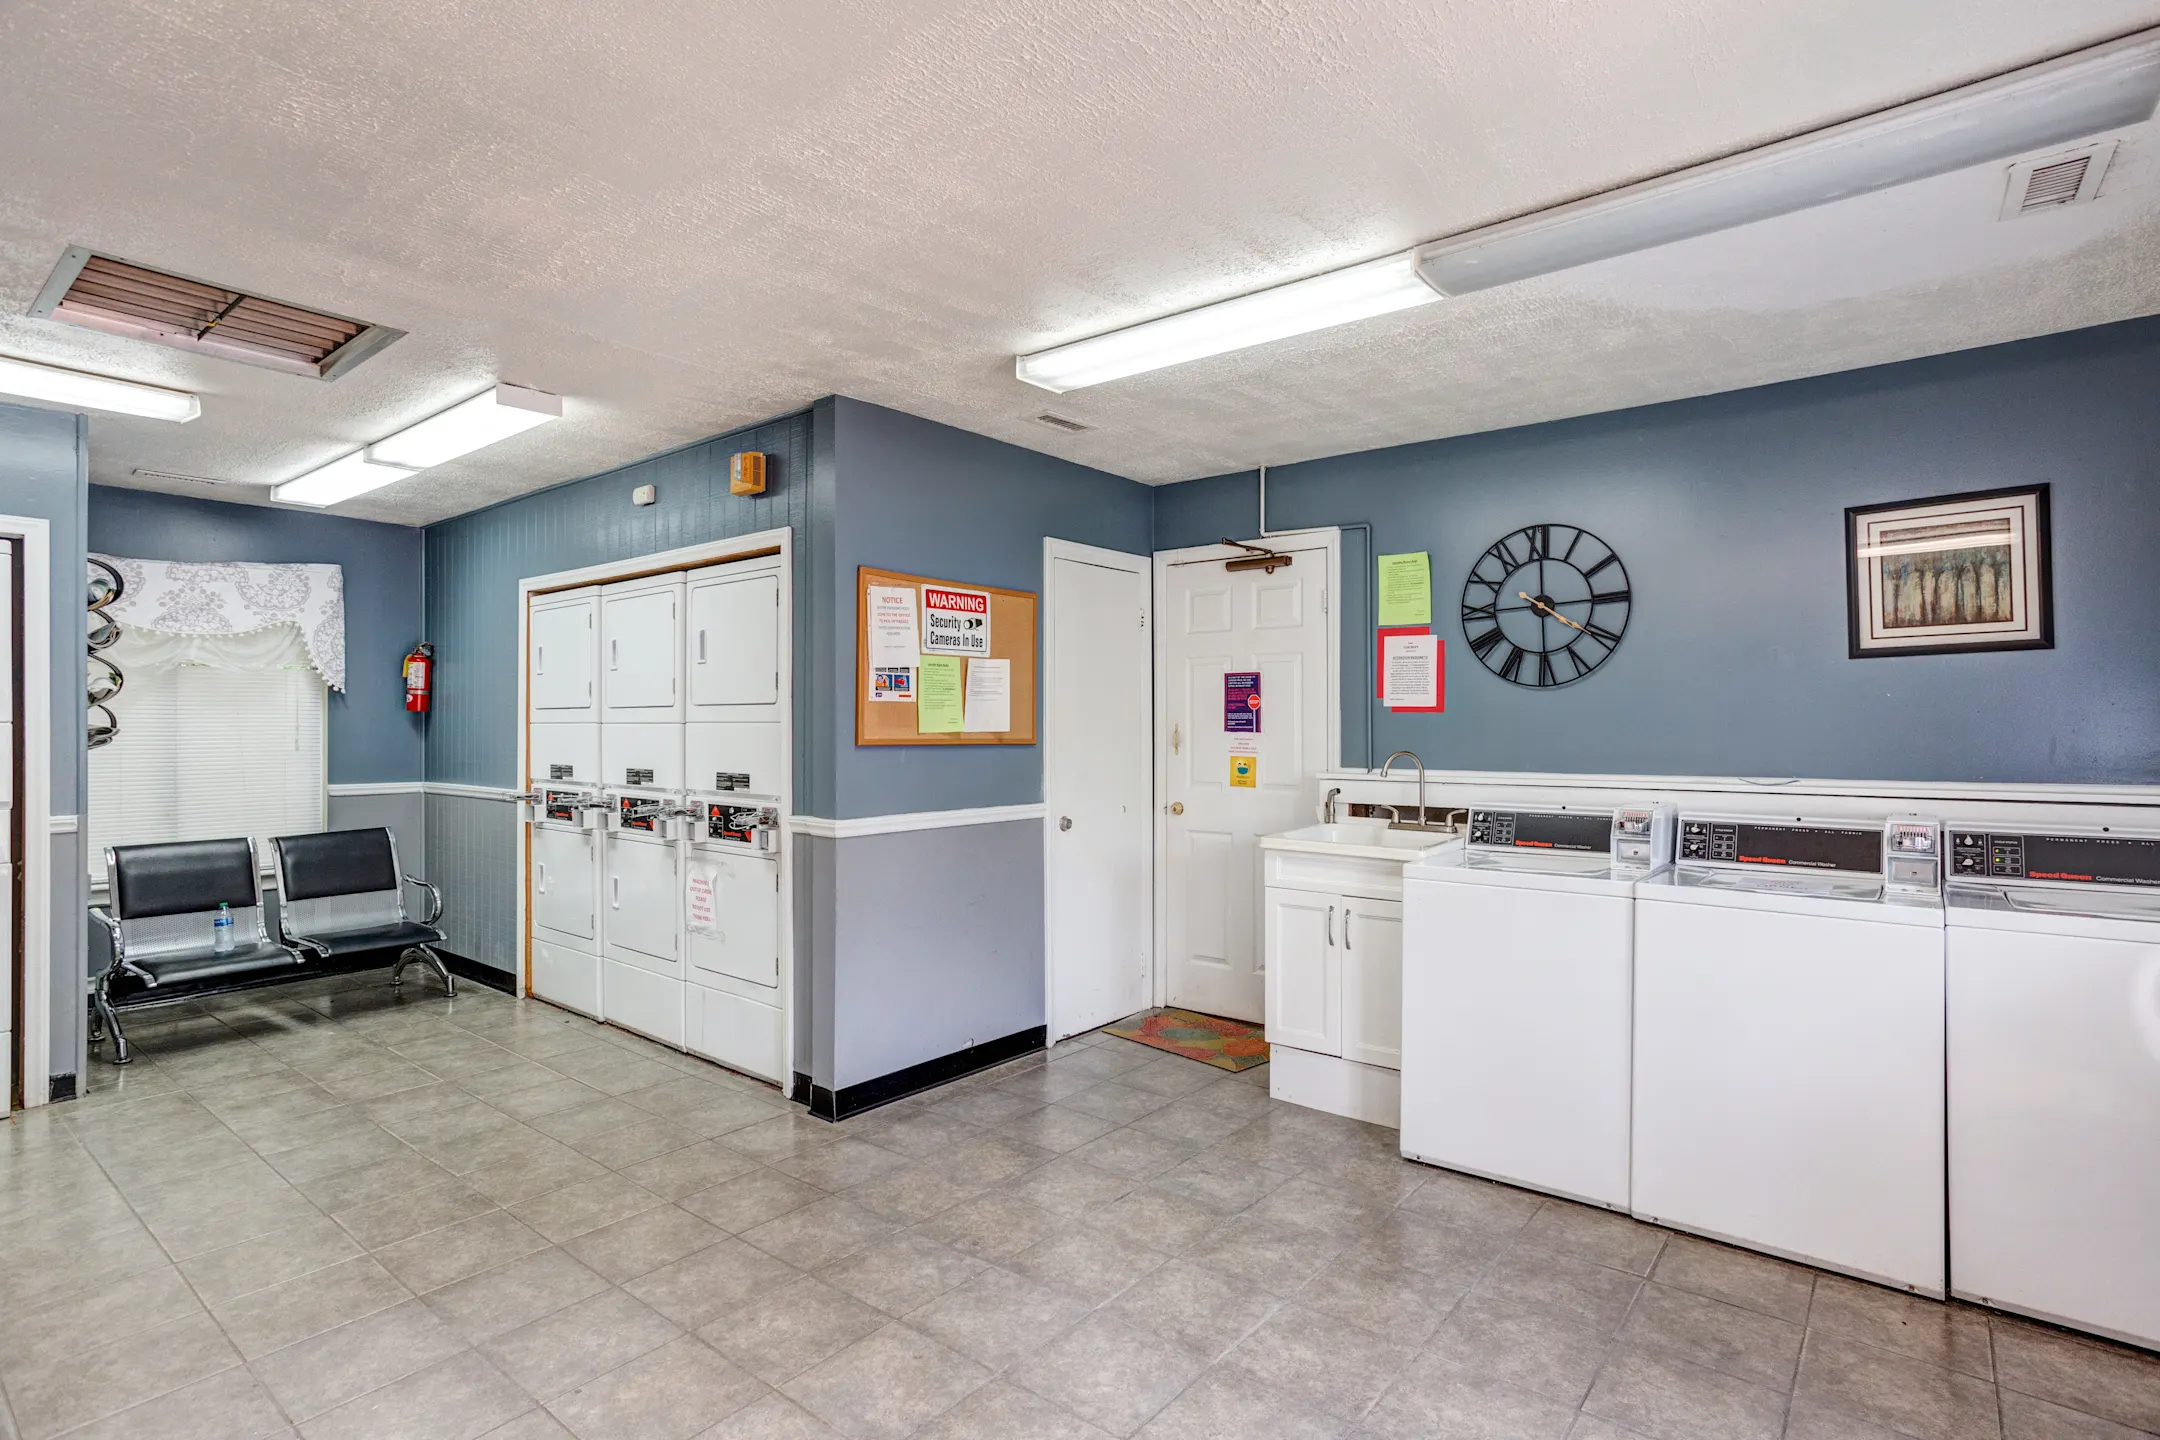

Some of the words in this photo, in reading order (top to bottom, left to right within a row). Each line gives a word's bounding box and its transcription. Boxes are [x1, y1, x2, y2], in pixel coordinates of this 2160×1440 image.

[881, 596, 904, 604] NOTICE
[928, 592, 985, 612] WARNING
[930, 613, 962, 632] Security
[930, 630, 961, 647] Cameras
[962, 633, 970, 647] In
[971, 634, 984, 648] Use
[1739, 855, 1762, 863] Speed
[2060, 872, 2093, 881] Queen
[2095, 875, 2135, 883] Commercial
